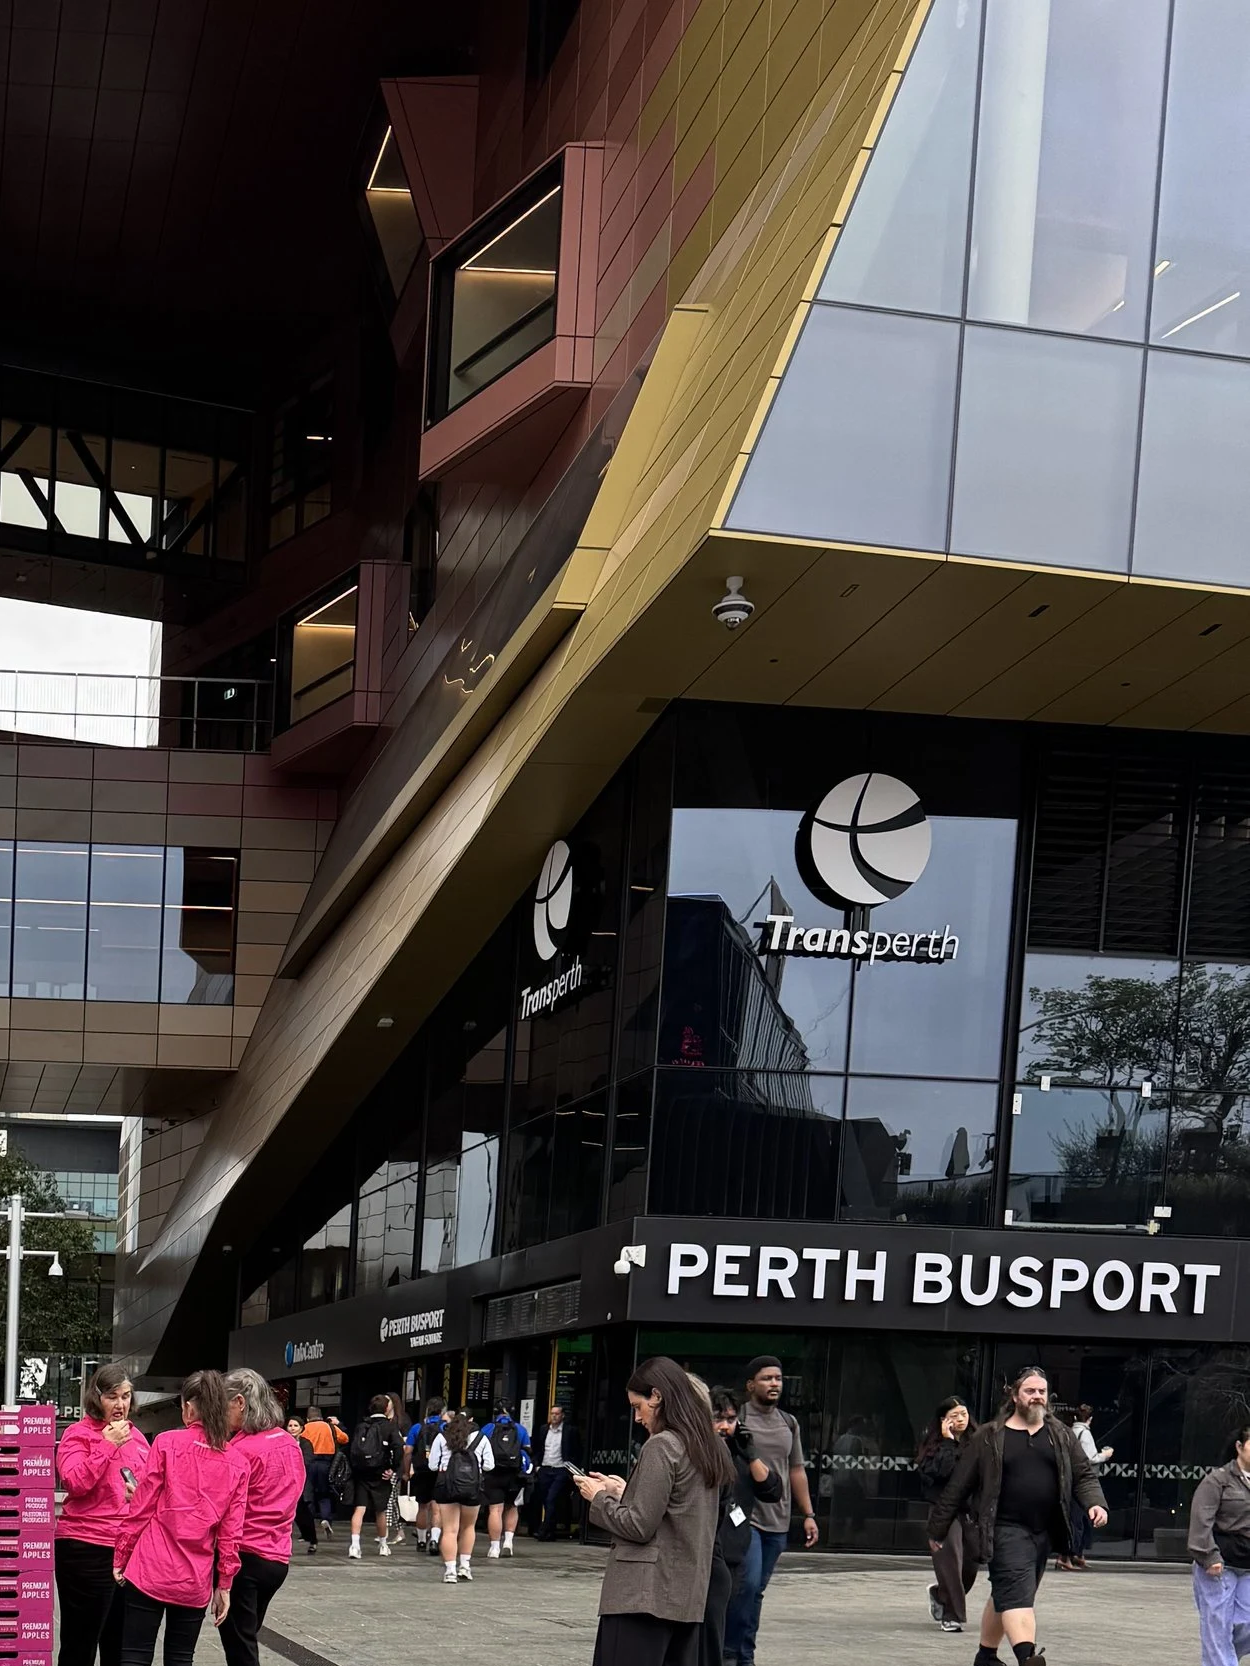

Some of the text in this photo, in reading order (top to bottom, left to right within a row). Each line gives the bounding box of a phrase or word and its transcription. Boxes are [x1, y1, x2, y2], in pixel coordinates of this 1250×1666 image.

[766, 914, 960, 965] Transperth
[520, 955, 582, 1020] Transperth
[667, 1243, 1221, 1315] PERTH BUSPORT
[389, 1309, 445, 1337] PERTH BUSPORT
[293, 1339, 325, 1363] InfoCentre
[23, 1459, 51, 1467] PREMIUM
[22, 1622, 49, 1630] PREMIUM
